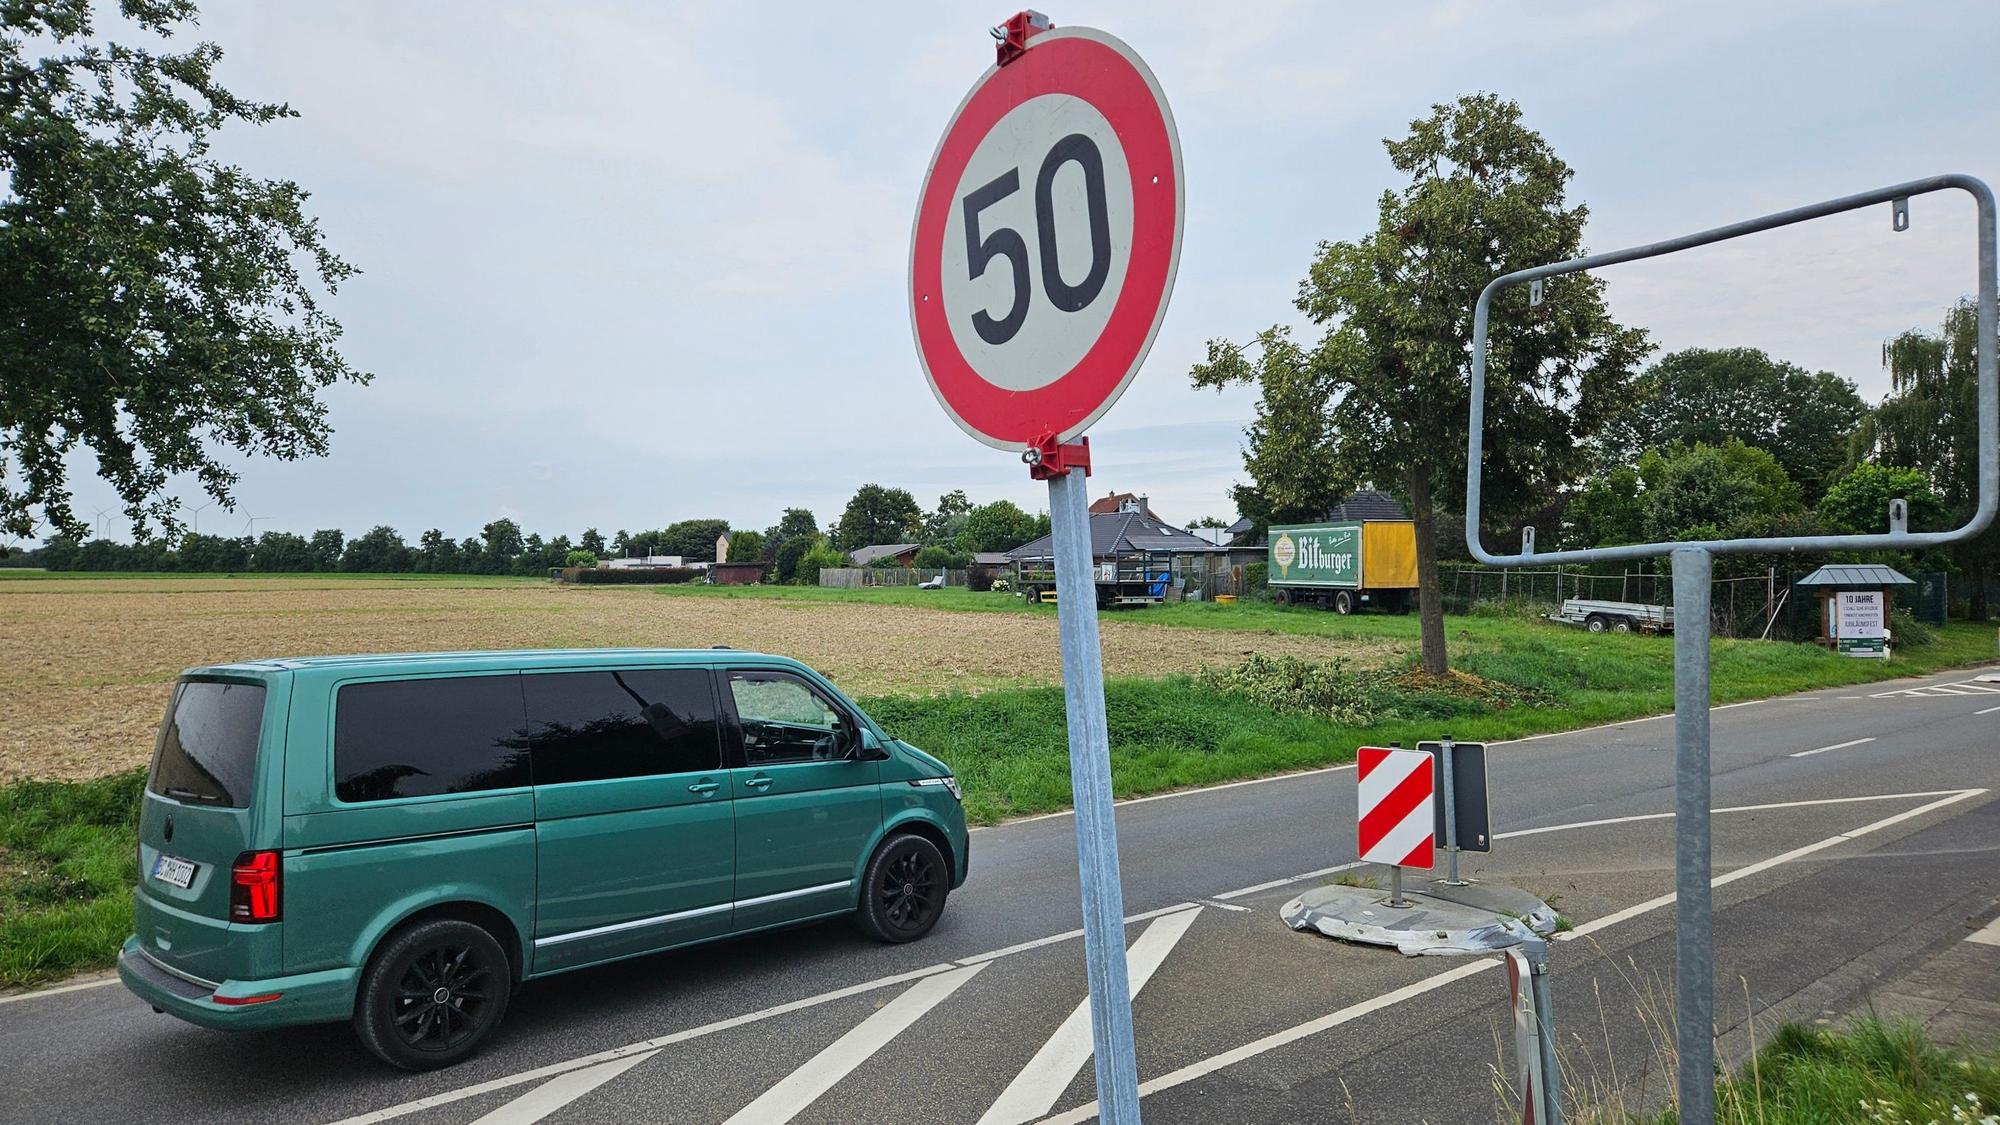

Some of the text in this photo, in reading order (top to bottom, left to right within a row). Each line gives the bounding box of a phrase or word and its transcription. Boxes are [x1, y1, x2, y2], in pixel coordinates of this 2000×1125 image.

[962, 133, 1111, 345] 50
[1298, 536, 1352, 574] Bitburger
[1845, 595, 1874, 603] 10 JAHRE
